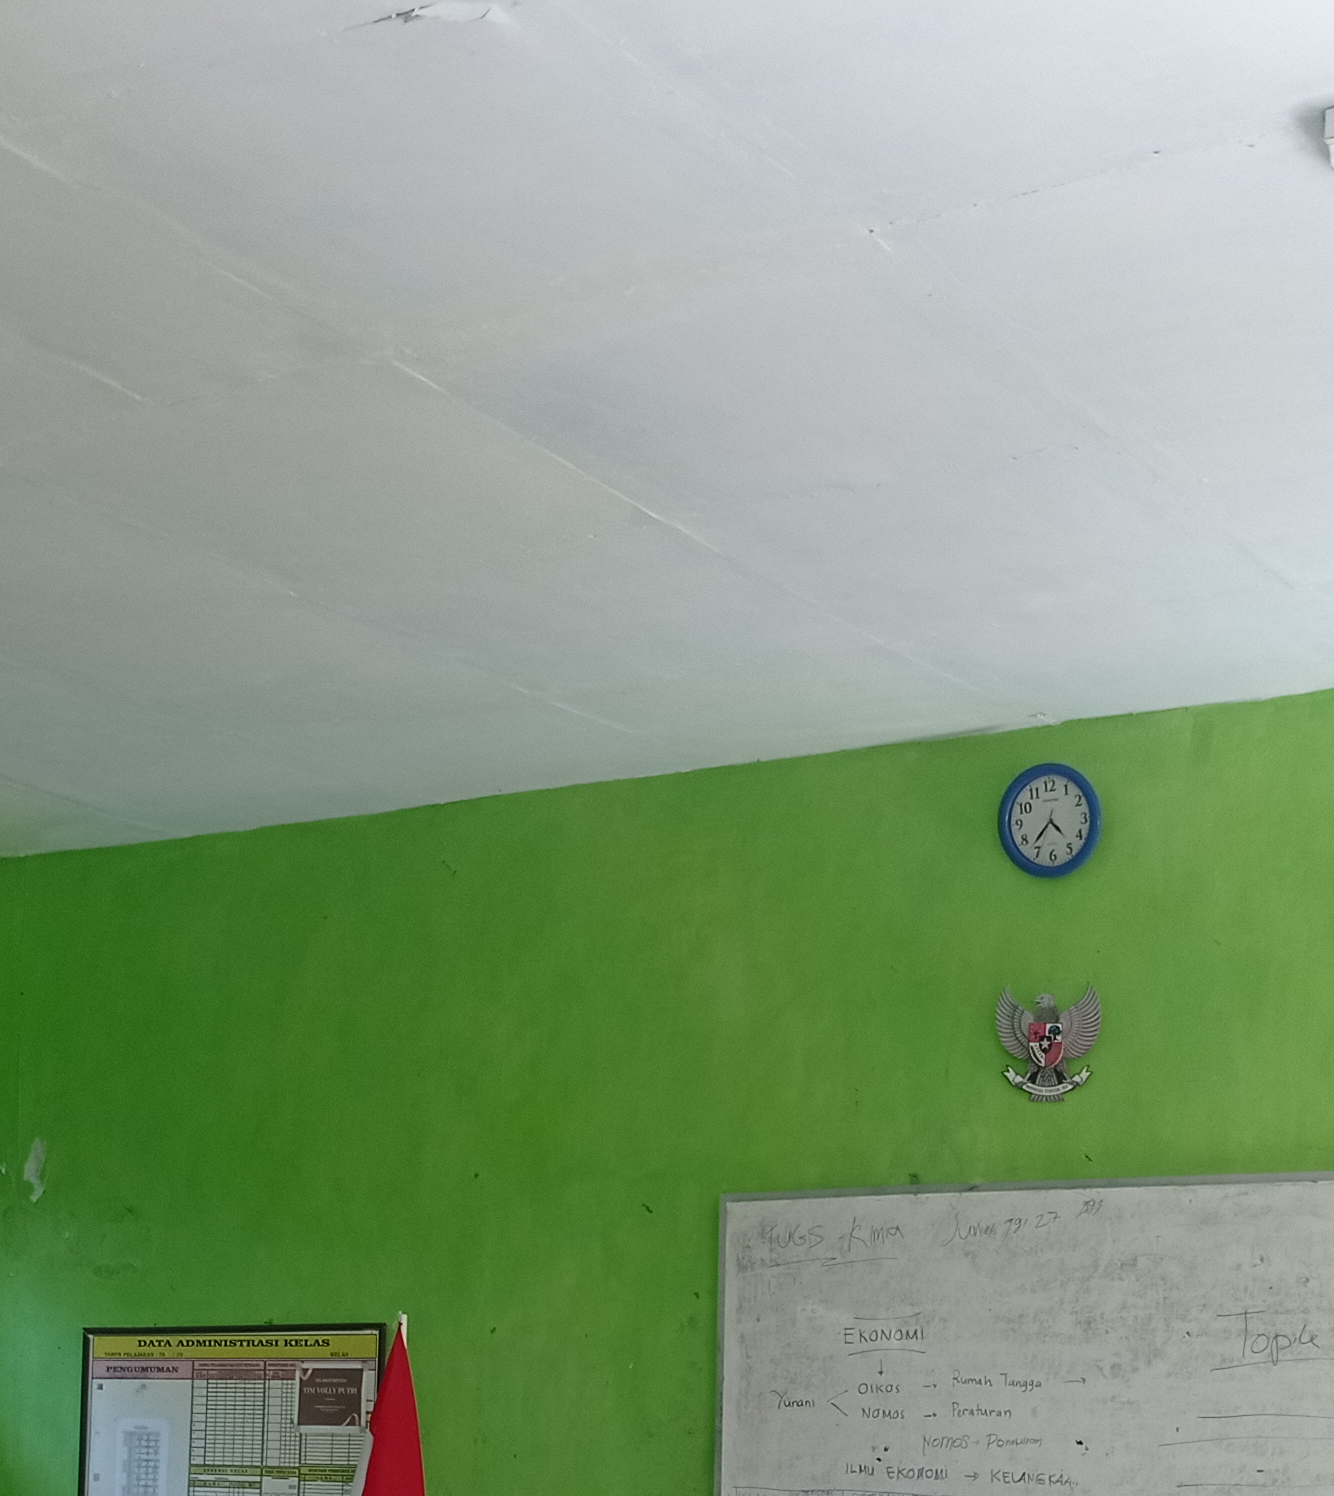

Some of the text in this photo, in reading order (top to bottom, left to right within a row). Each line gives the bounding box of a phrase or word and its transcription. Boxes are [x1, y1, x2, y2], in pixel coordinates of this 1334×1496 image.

[1043, 779, 1056, 793] 12
[1063, 783, 1069, 796] 1
[1029, 786, 1040, 800] 11
[1074, 794, 1083, 807] 2
[1019, 801, 1032, 815] 10
[1015, 819, 1023, 831] 9
[1080, 812, 1088, 825] 3
[1020, 833, 1029, 846] 8
[1075, 828, 1083, 841] 4
[1034, 845, 1042, 858] 7
[1066, 842, 1073, 855] 5
[1049, 849, 1057, 862] 6
[843, 1327, 926, 1344] EKONOMI
[138, 1338, 331, 1348] DATA ADMINISTRASI KELAS
[857, 1383, 900, 1395] OIKOS
[1000, 1373, 1042, 1393] Tangga
[770, 1390, 816, 1409] Yunani
[862, 1402, 1012, 1420] NOMOS Peraturan
